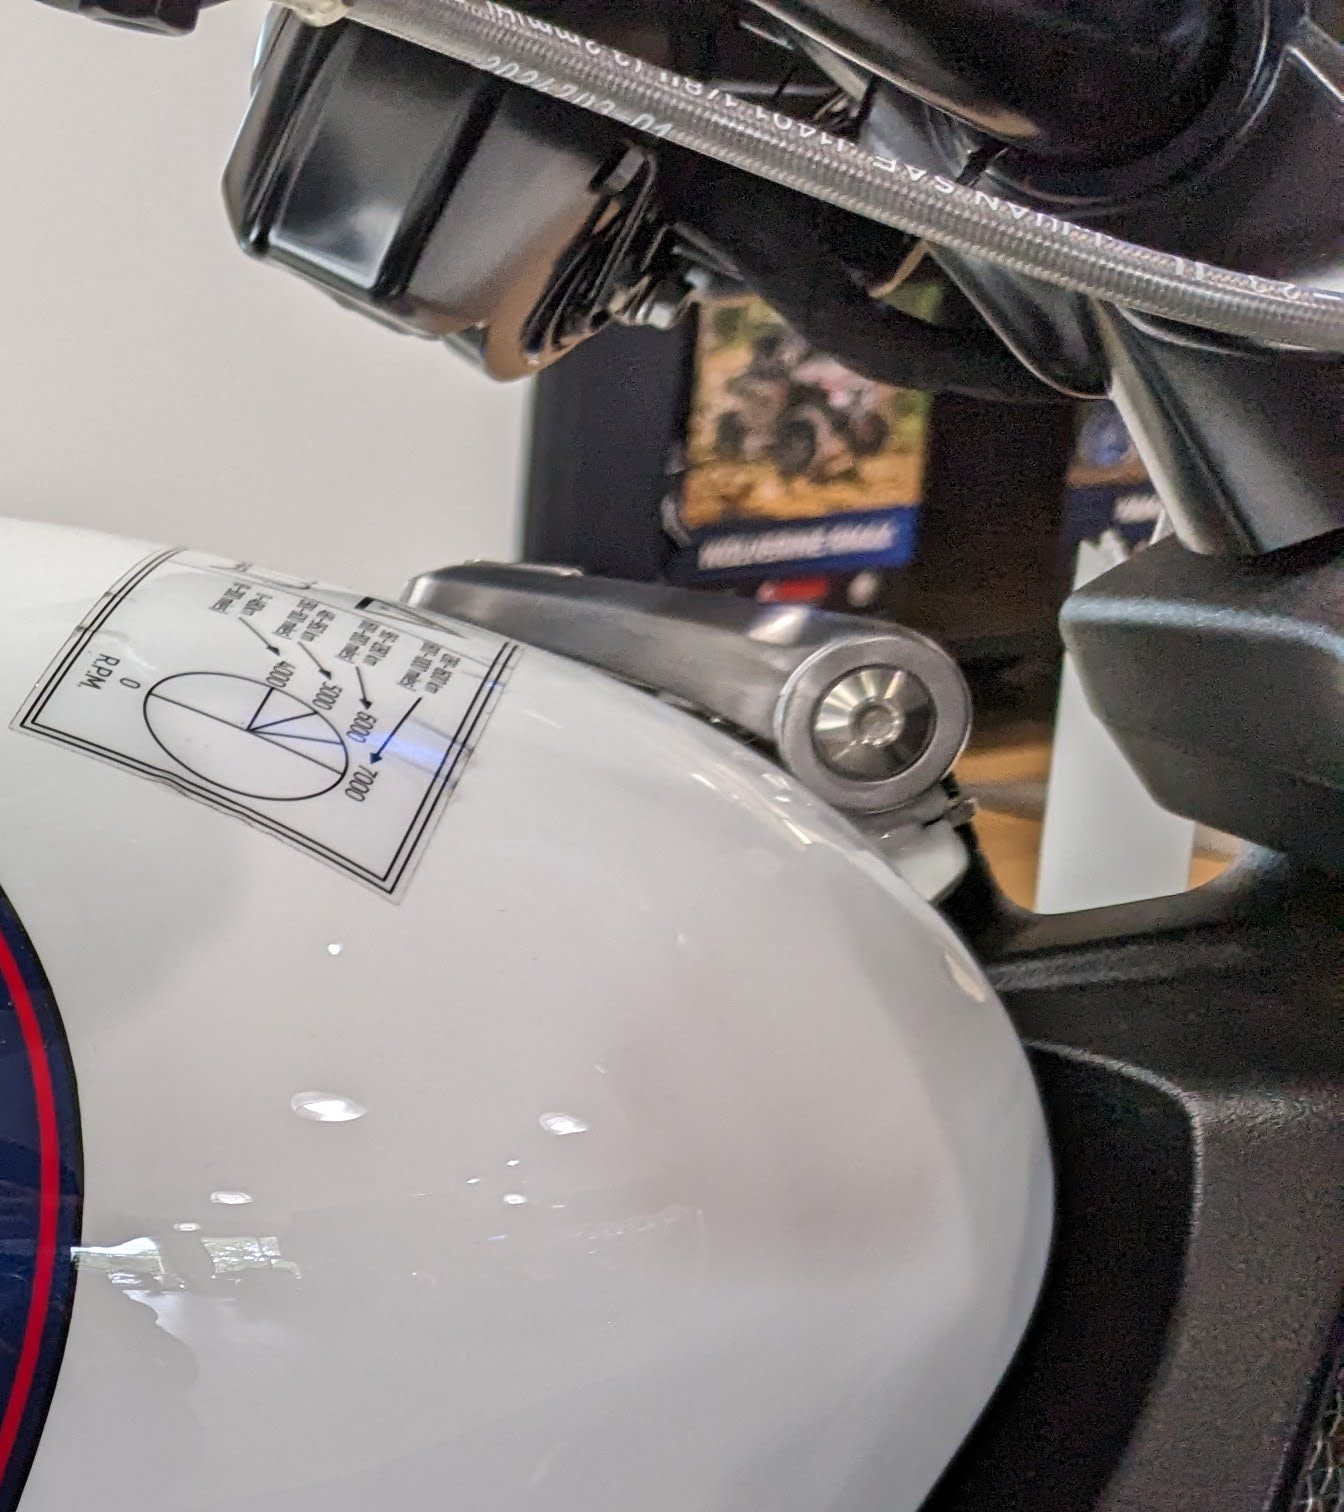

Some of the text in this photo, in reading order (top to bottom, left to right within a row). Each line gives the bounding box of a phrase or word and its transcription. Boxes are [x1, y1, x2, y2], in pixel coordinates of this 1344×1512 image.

[266, 660, 295, 688] 4000
[312, 681, 343, 711] 5000
[346, 711, 377, 743] 6000
[345, 765, 378, 802] 7000
